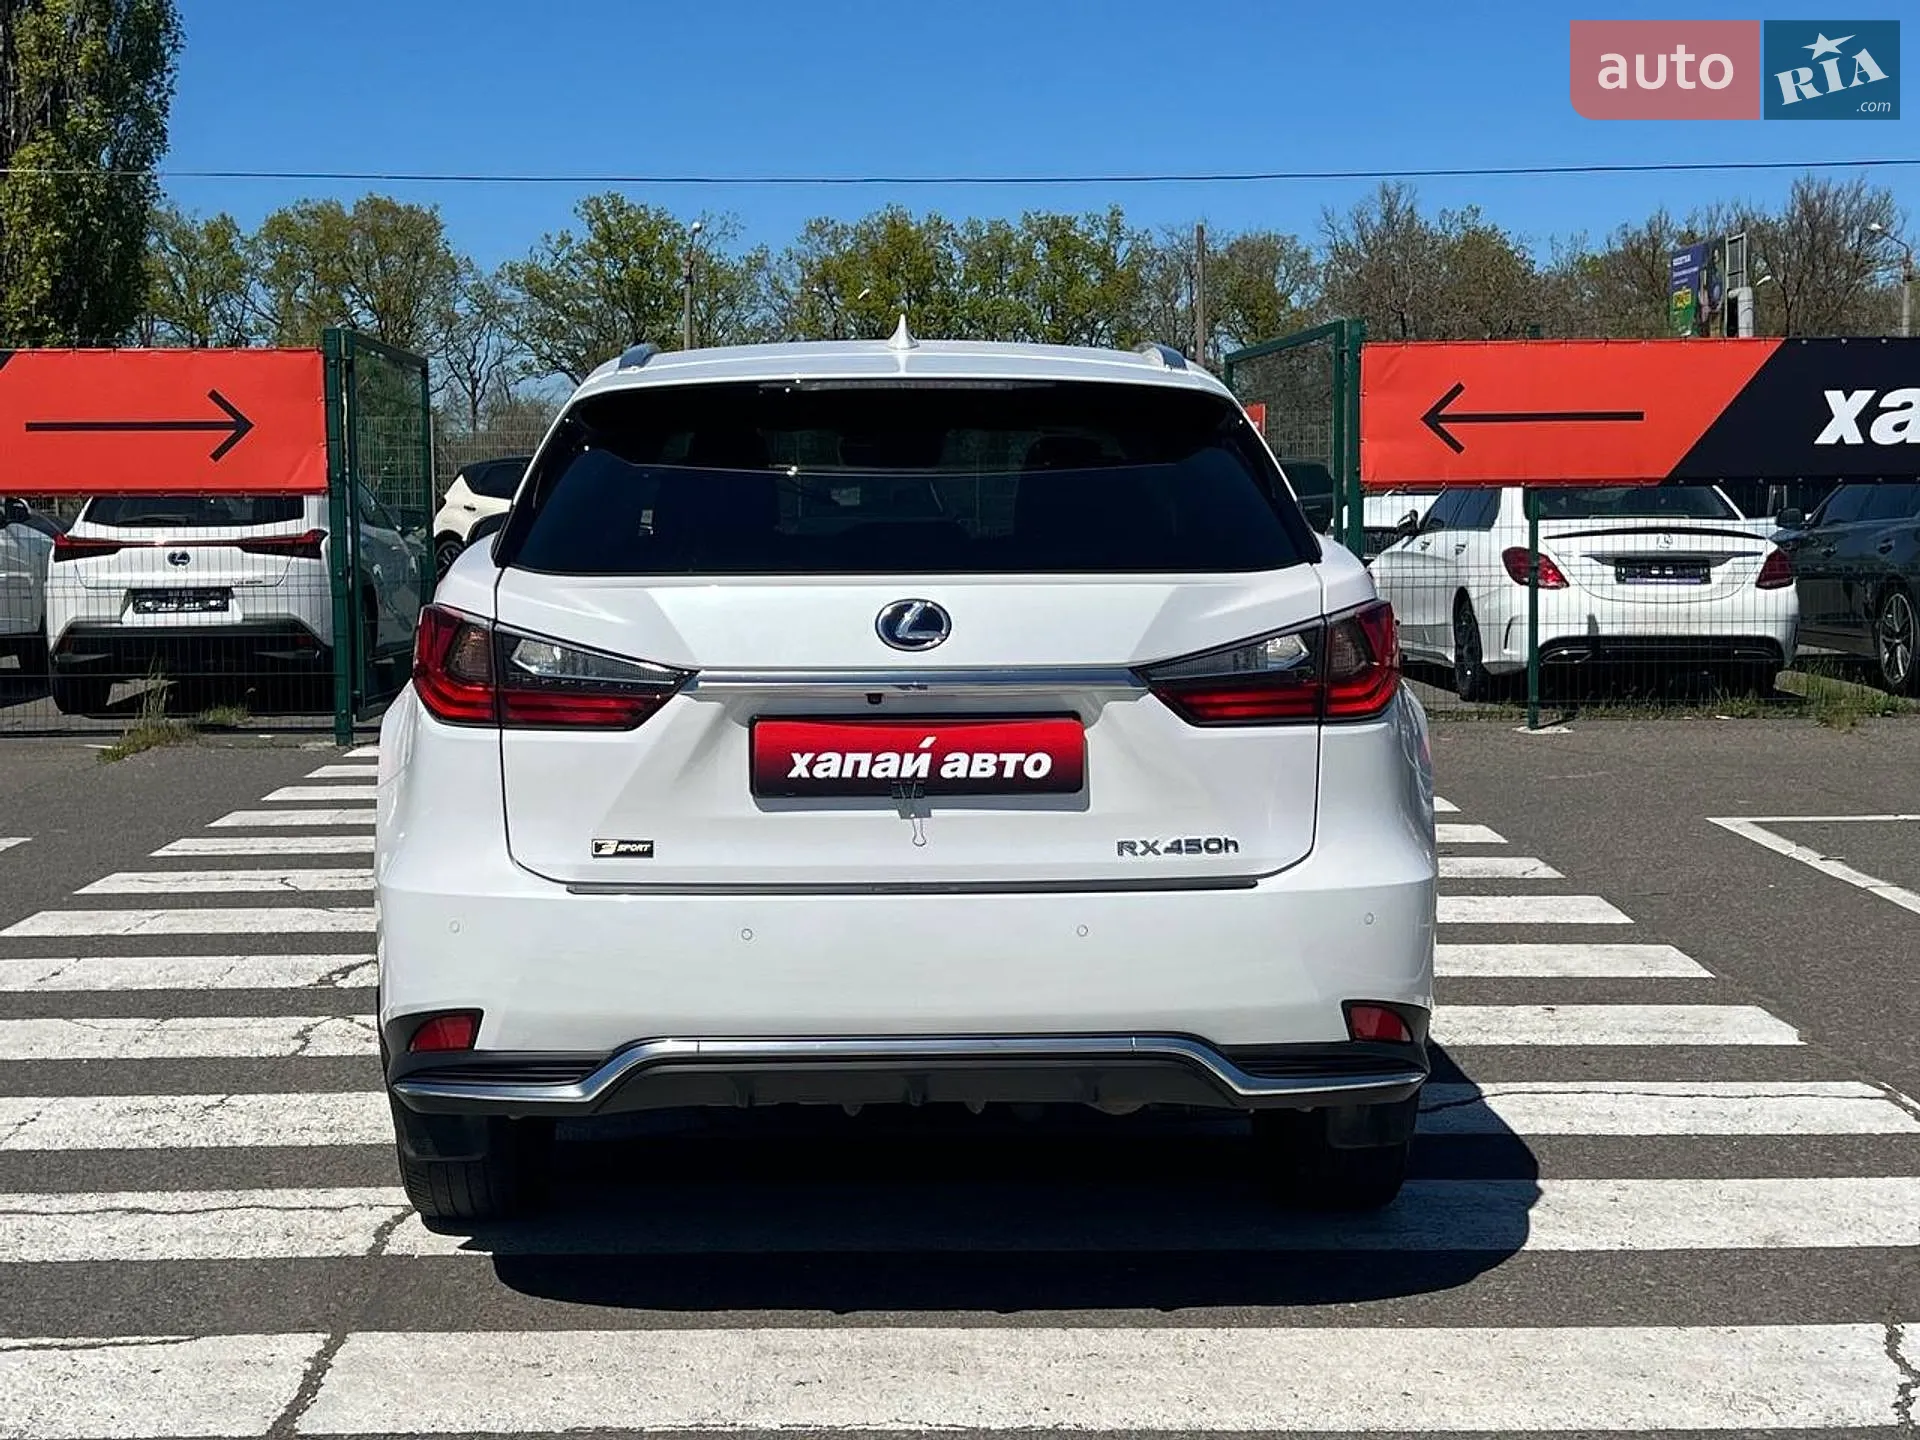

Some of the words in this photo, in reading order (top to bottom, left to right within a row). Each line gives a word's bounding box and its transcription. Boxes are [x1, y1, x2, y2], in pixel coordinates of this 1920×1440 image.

[1813, 387, 1920, 446] ха
[786, 736, 936, 779] хапай
[939, 751, 1052, 779] авто
[616, 843, 652, 852] SPORT
